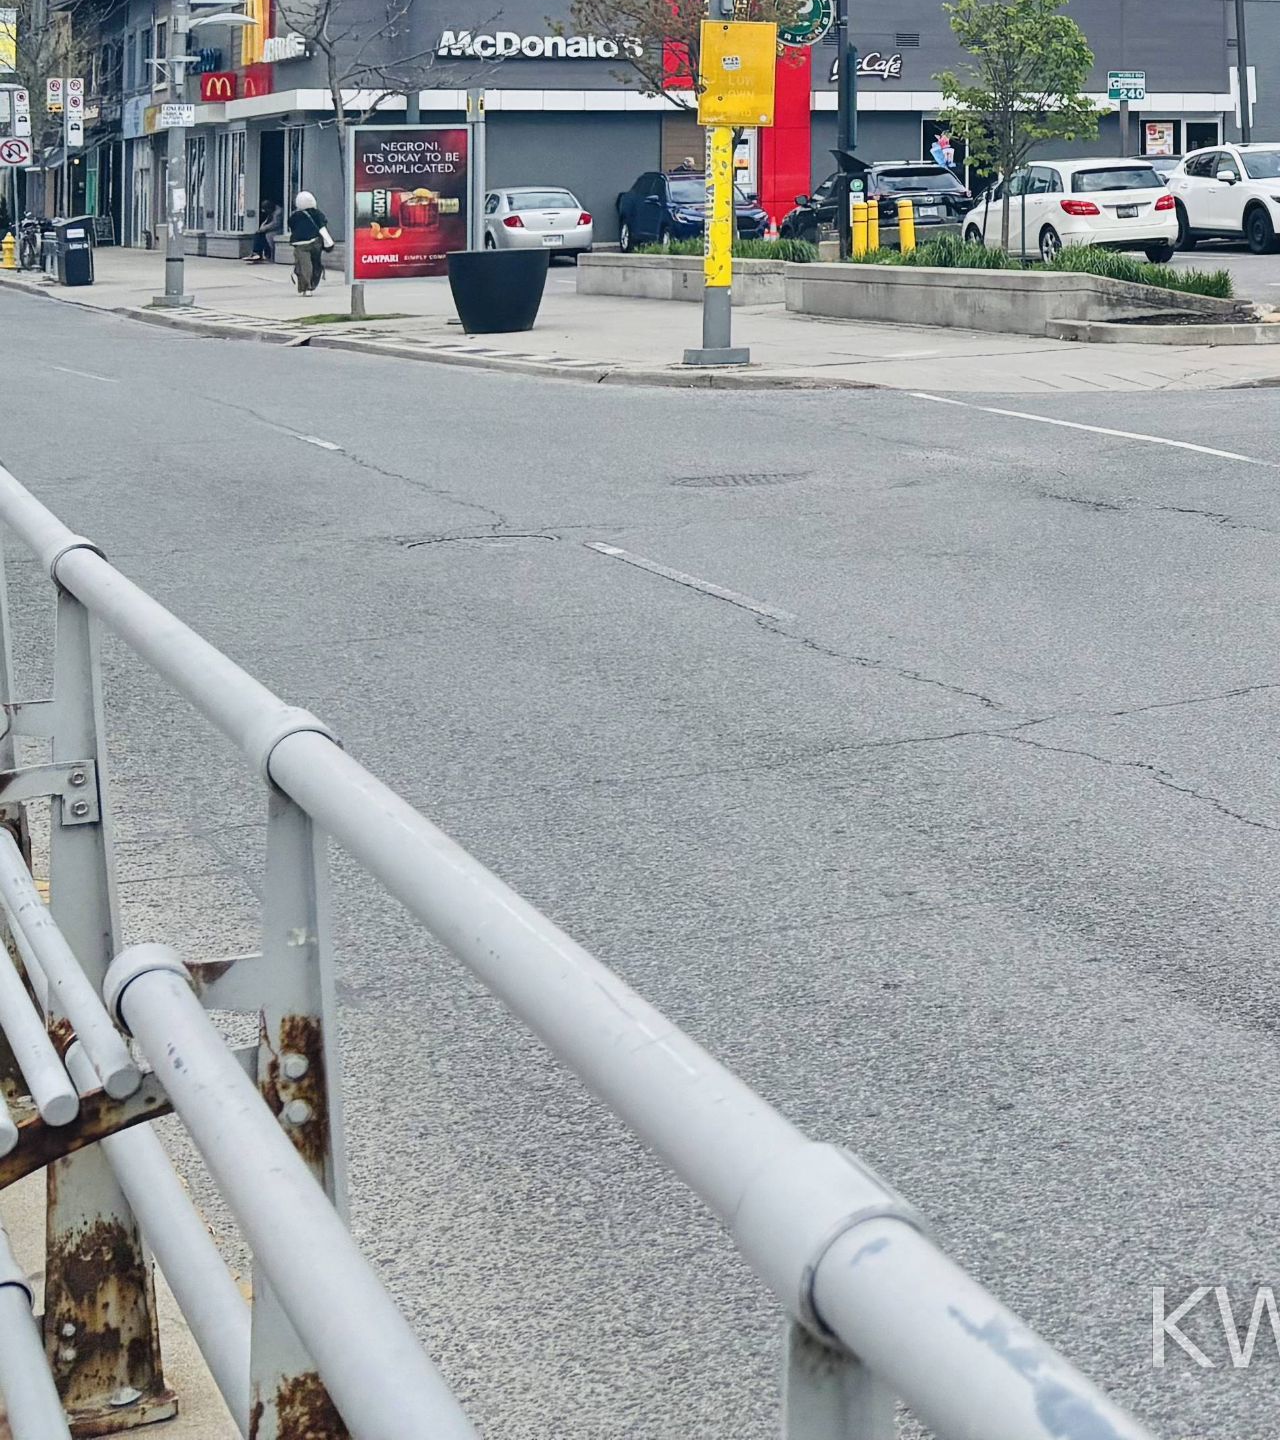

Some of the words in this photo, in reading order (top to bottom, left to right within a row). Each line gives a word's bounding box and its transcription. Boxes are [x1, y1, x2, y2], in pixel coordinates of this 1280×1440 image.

[1120, 88, 1143, 99] 240
[380, 142, 441, 152] NEGRONI.
[363, 153, 385, 163] IT'S
[387, 153, 421, 163] OKAY
[425, 152, 441, 162] TO
[445, 152, 460, 162] BE
[365, 163, 456, 174] COMPLICATED.
[362, 254, 399, 263] CAMPARI
